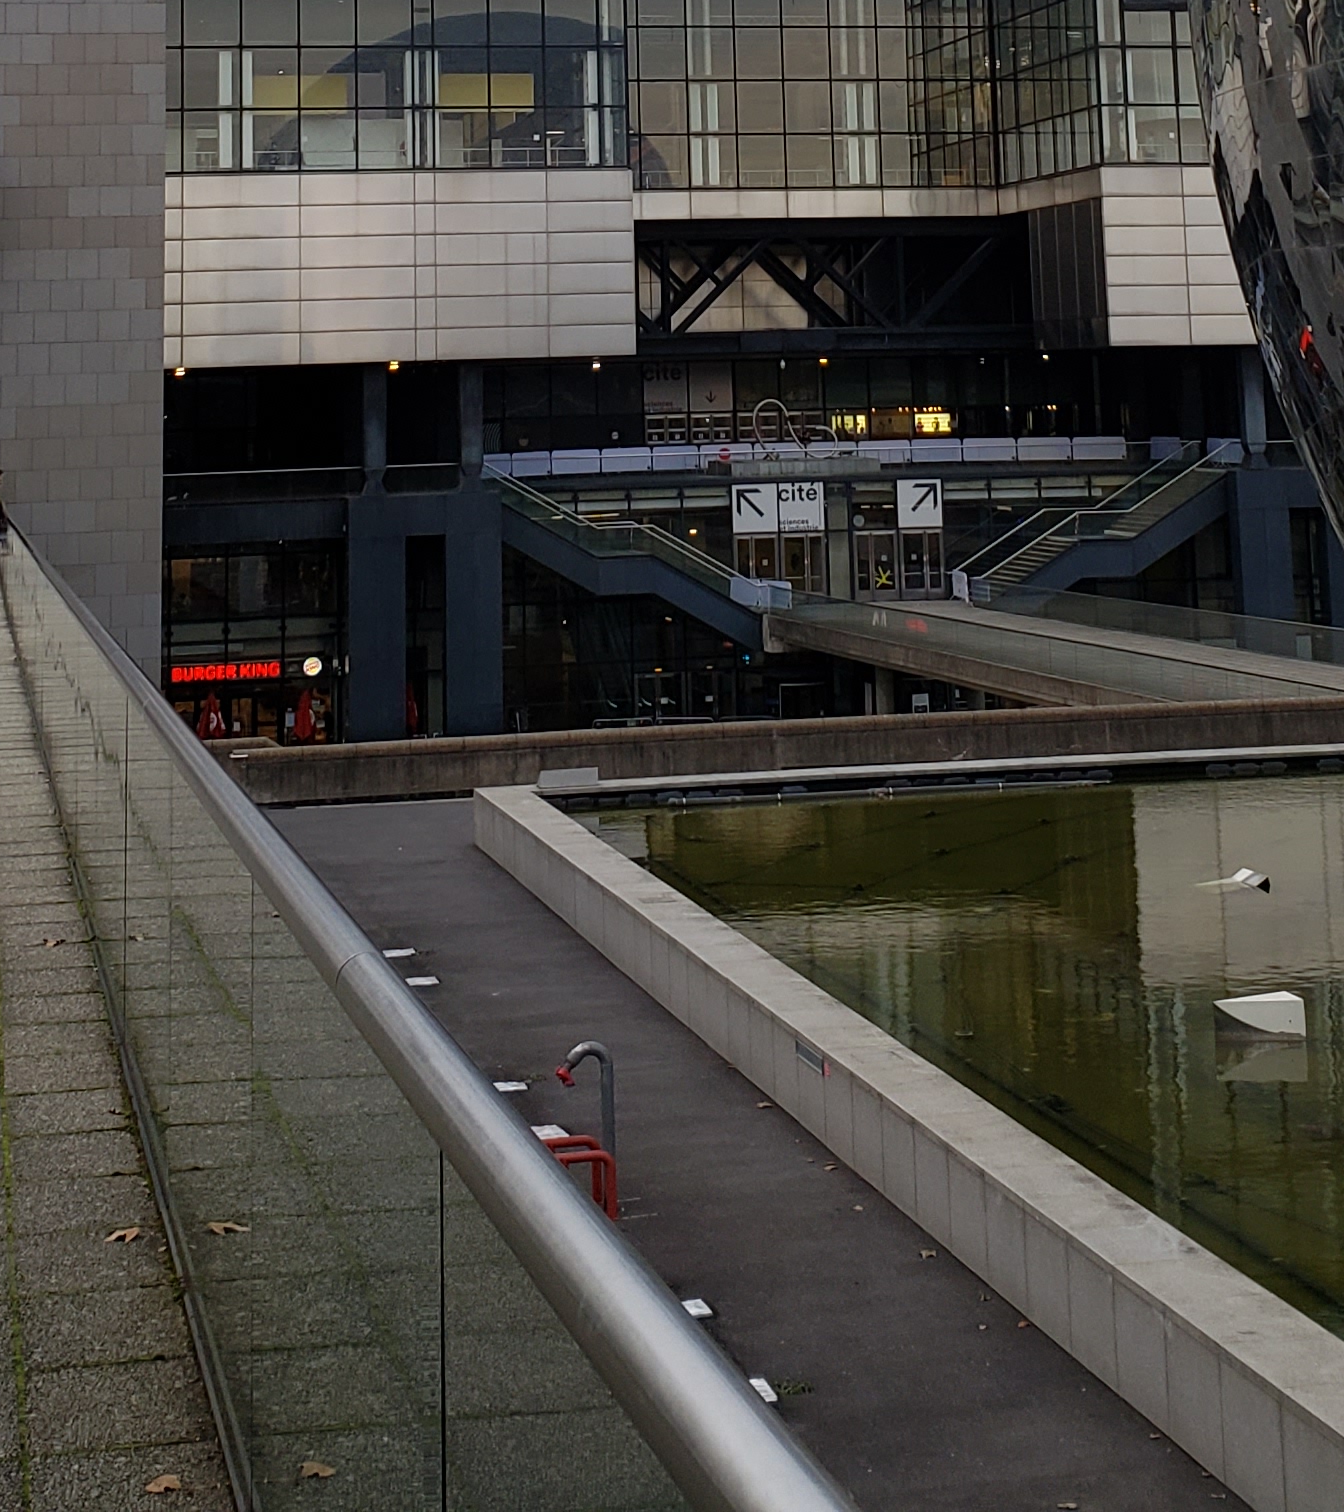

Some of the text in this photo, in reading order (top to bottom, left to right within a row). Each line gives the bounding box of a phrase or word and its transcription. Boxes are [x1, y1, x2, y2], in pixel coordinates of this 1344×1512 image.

[778, 481, 818, 502] cité
[171, 661, 280, 682] BURGER KING
